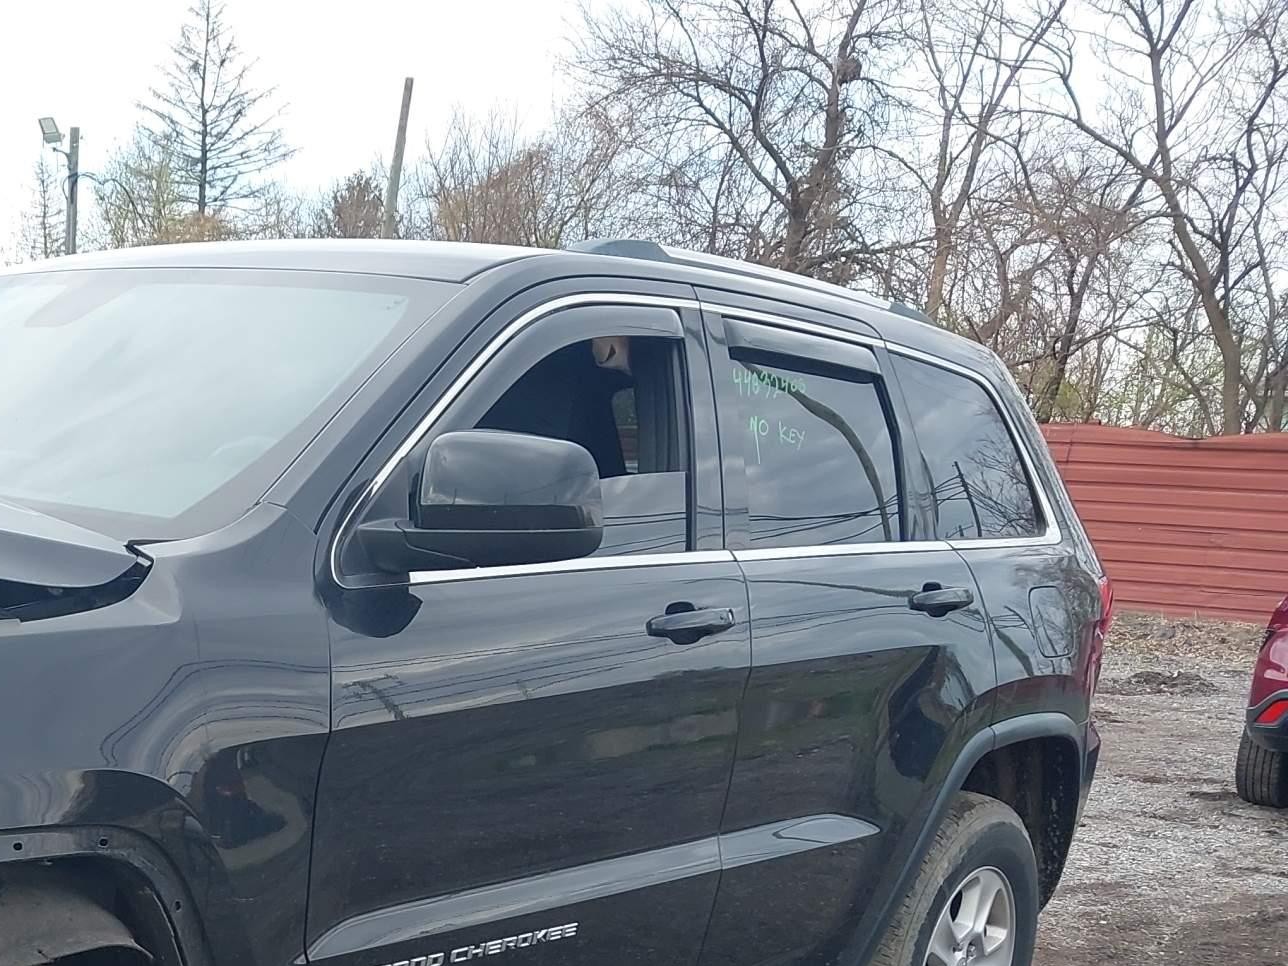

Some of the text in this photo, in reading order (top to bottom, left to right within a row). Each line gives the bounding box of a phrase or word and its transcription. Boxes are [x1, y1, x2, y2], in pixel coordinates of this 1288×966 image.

[750, 415, 806, 464] NO KEY
[450, 922, 579, 963] CHEROKEE
